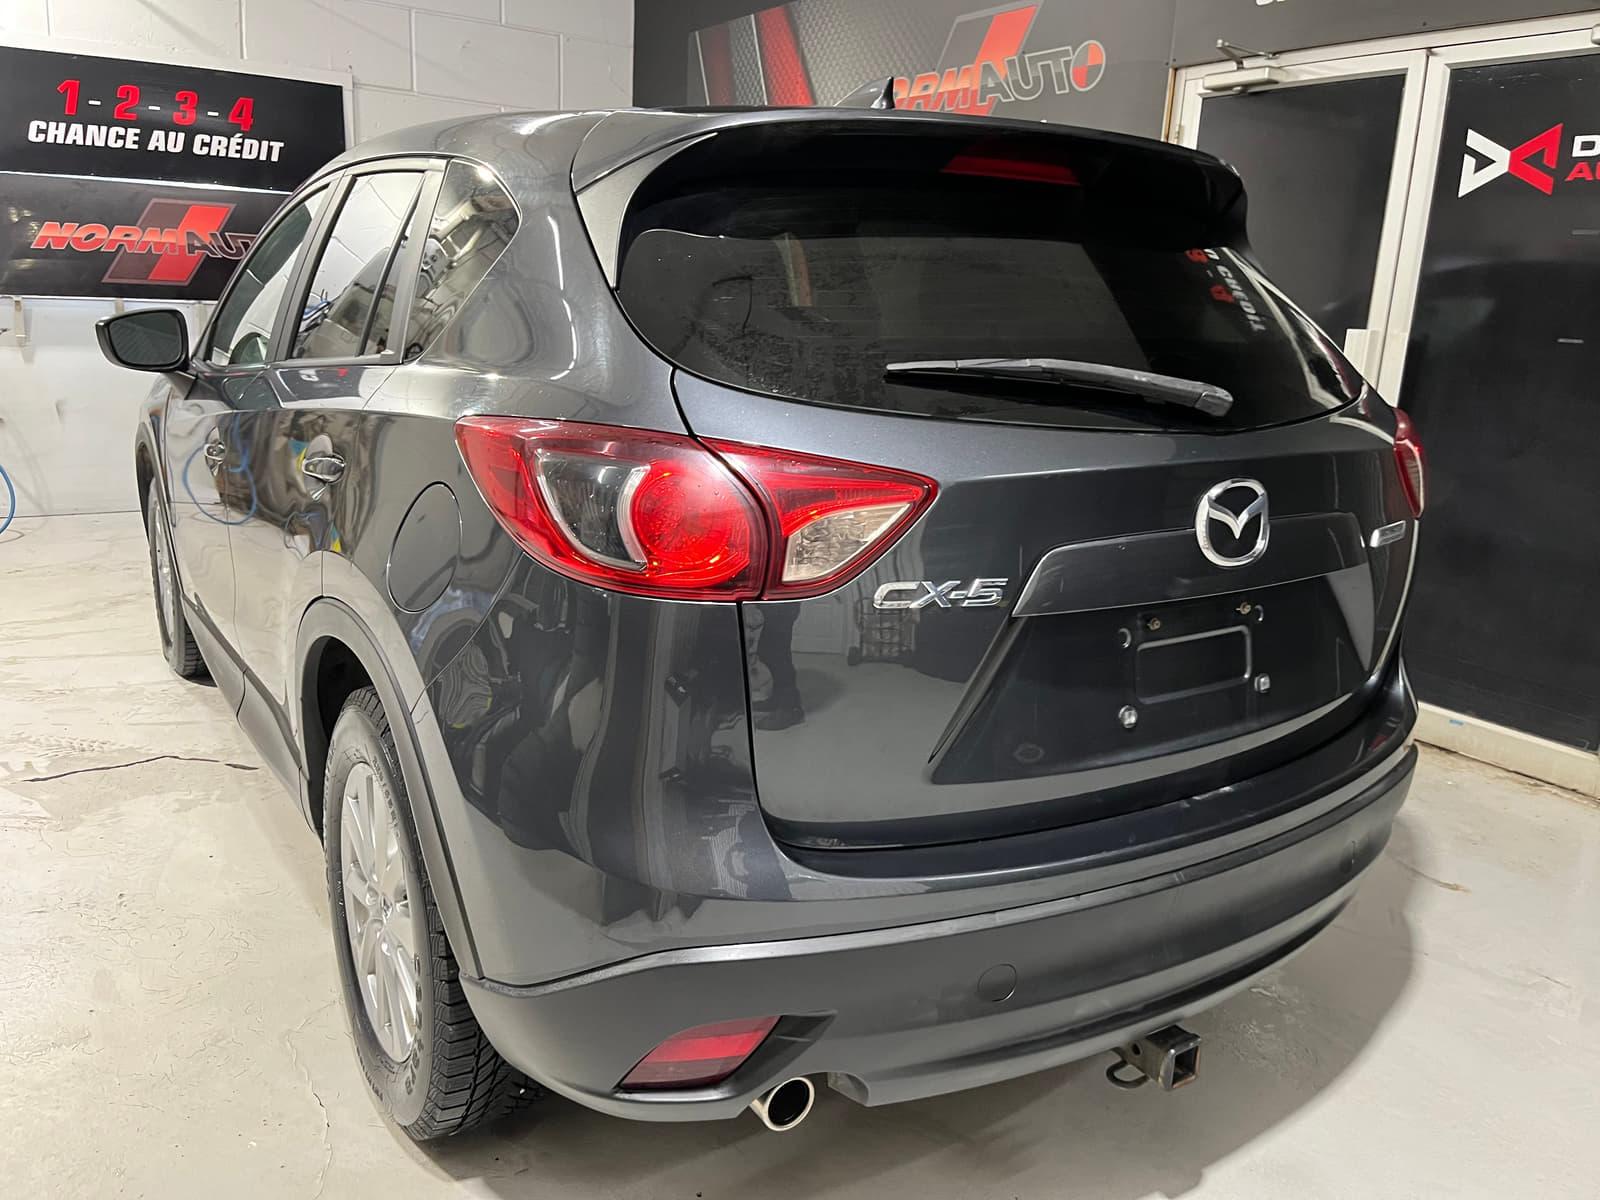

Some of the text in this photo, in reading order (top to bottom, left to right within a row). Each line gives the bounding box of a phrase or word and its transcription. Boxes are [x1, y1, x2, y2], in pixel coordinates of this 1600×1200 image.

[57, 79, 80, 115] 1
[113, 84, 140, 121] 2
[172, 90, 198, 126] 3
[228, 97, 254, 132] 4
[28, 120, 285, 162] CHANCE AU CRÉDIT
[873, 578, 1009, 609] CX-5
